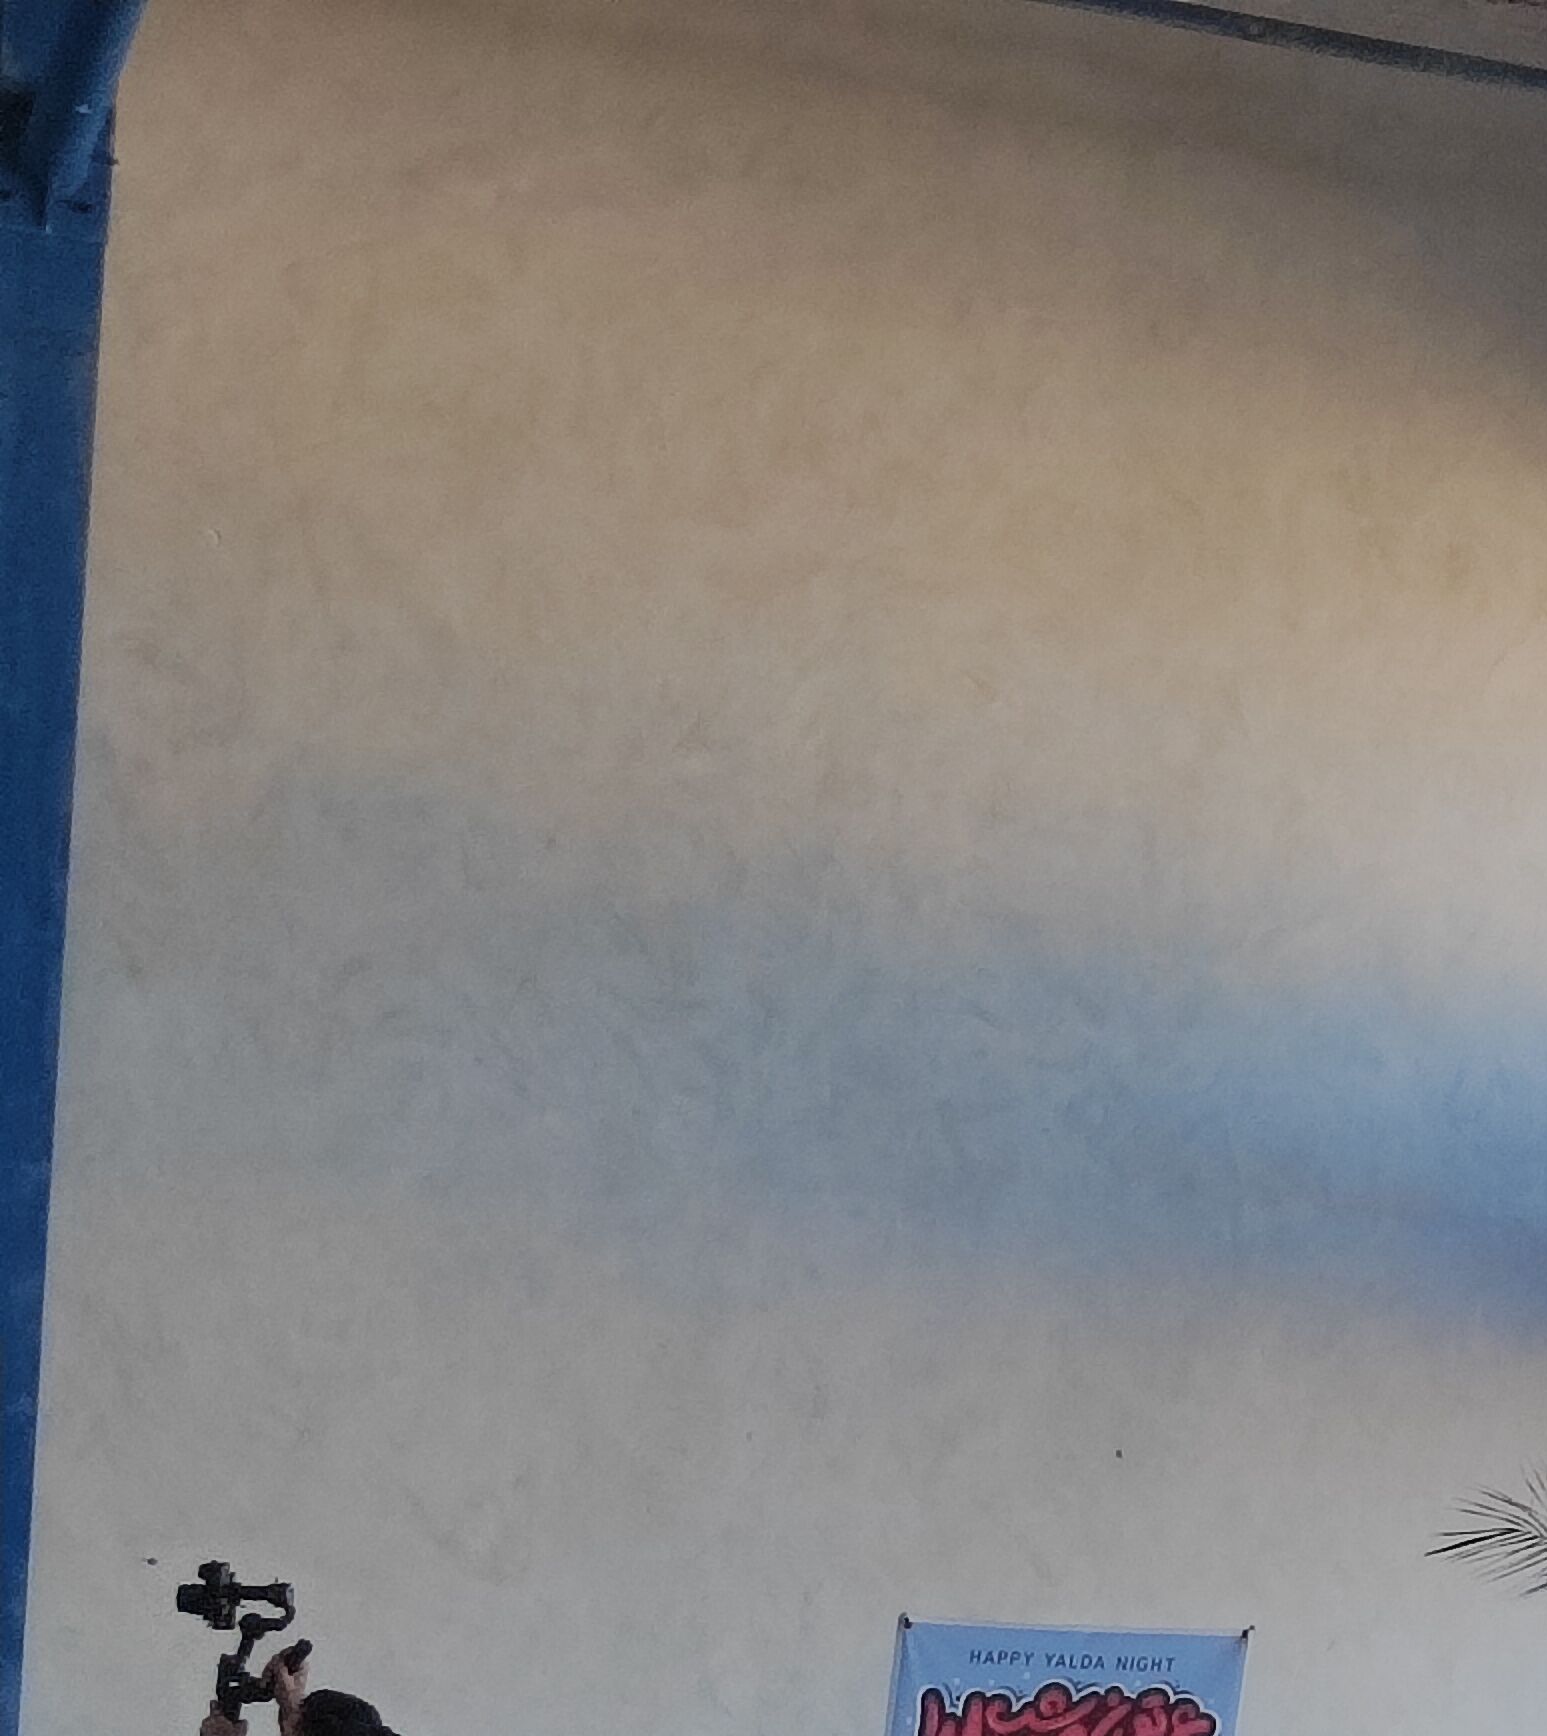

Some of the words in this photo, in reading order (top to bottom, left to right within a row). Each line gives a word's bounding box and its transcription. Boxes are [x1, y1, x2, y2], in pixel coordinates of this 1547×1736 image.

[968, 1648, 1035, 1667] HAPPY
[1043, 1652, 1106, 1671] YALDA
[1114, 1655, 1177, 1674] NIGHT
